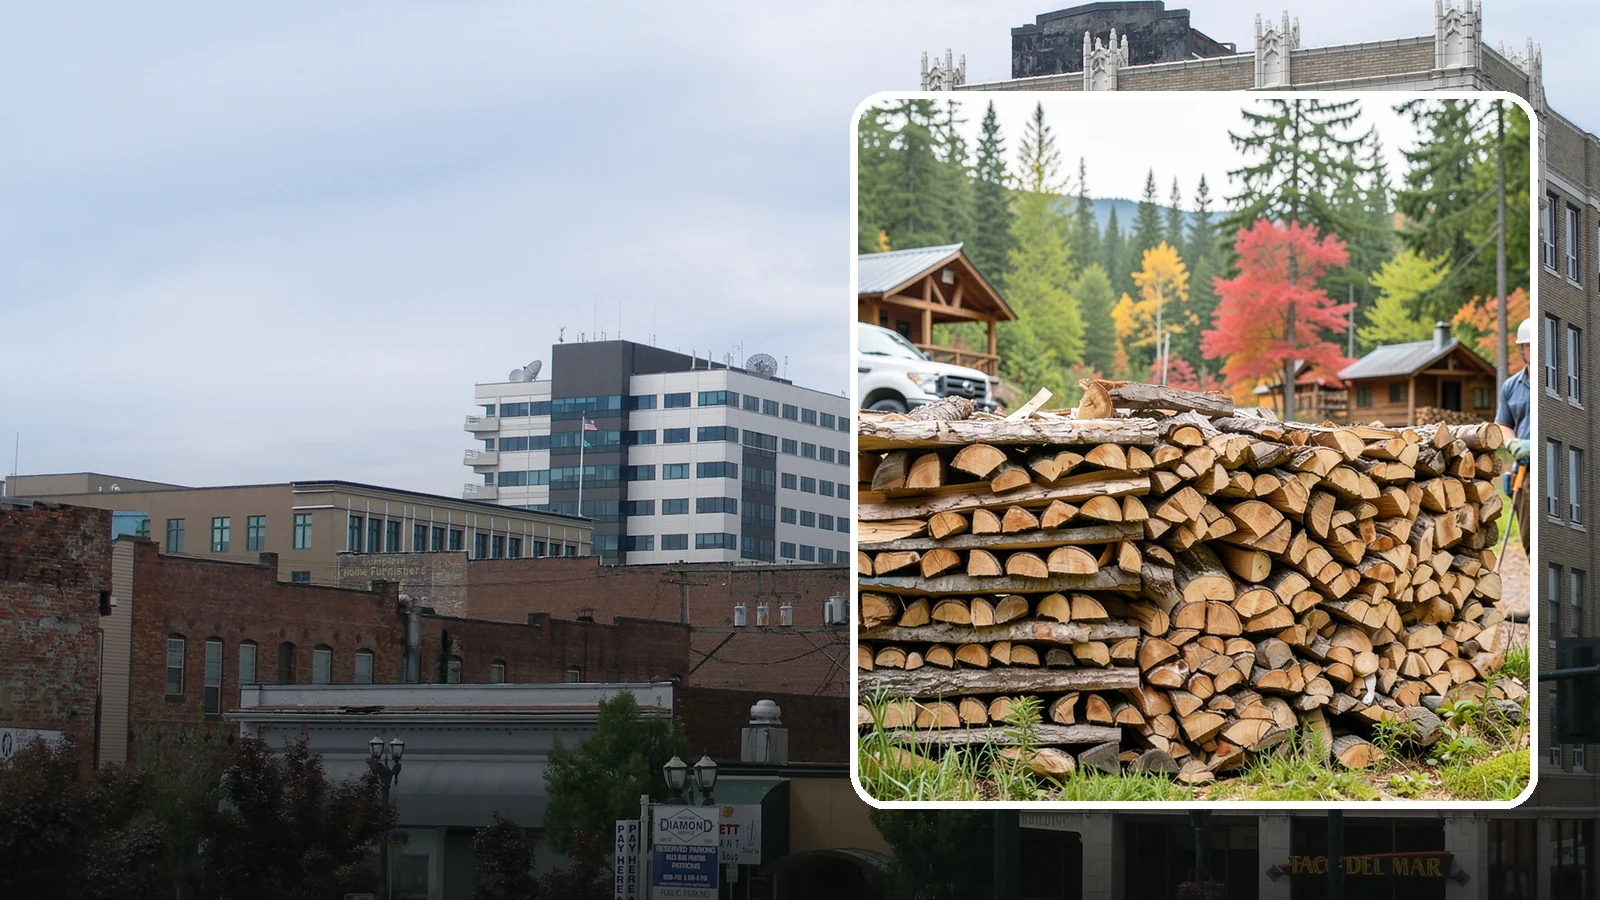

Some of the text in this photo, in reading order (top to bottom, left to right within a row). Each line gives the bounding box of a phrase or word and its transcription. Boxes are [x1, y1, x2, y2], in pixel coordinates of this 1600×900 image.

[370, 566, 427, 577] Furnishers
[660, 818, 713, 832] DIAMOND
[1022, 815, 1069, 828] BUILDING
[656, 845, 716, 855] RESERVED PARKING
[616, 825, 625, 893] PAY HERE
[627, 824, 637, 893] PAY HERE
[722, 851, 739, 863] Soup
[671, 862, 701, 870] PATRONS
[1346, 857, 1385, 875] DEL
[1393, 858, 1443, 877] MAR
[660, 888, 710, 898] PUBLIC PARKING
